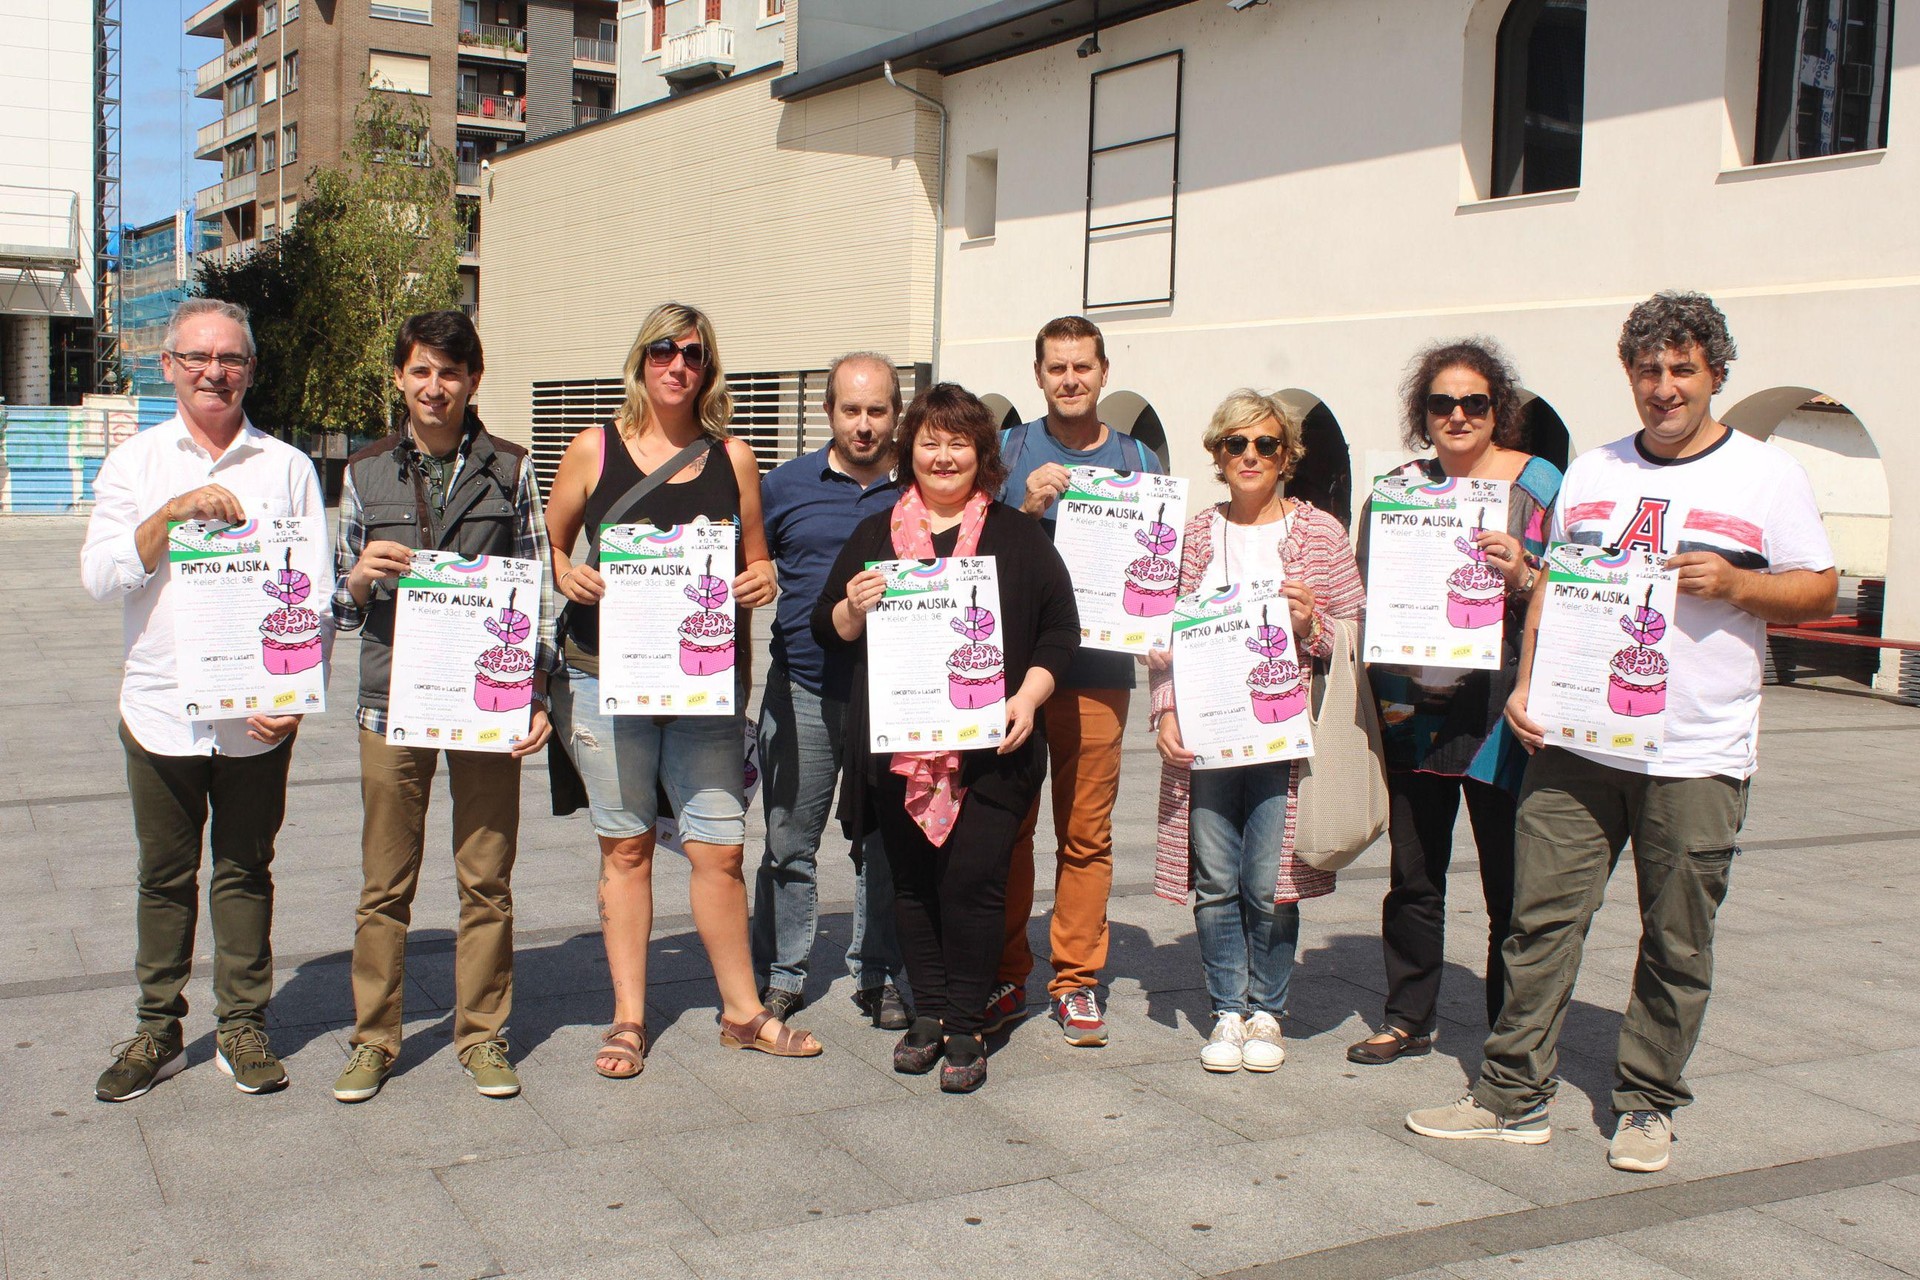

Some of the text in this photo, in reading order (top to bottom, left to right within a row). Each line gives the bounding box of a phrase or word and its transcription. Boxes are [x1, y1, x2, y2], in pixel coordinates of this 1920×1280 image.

[1154, 477, 1160, 485] 16
[1471, 480, 1479, 489] 16
[1068, 502, 1144, 521] PINTXO MUSIKA
[273, 520, 282, 529] 16
[1076, 518, 1096, 526] Keler
[1381, 514, 1463, 528] PINTXO MUSIKA
[1610, 497, 1670, 555] A
[697, 528, 705, 536] 16
[1390, 529, 1411, 537] Keler
[503, 560, 511, 568] 16
[960, 559, 968, 568] 16
[1644, 555, 1652, 564] 16
[181, 561, 270, 575] PINTXO MUSIKA
[610, 564, 691, 575] PINTXO MUSIKA
[242, 576, 253, 584] 3€
[665, 579, 675, 587] 3€
[1252, 581, 1259, 589] 16
[408, 590, 493, 607] PINTXO MUSIKA
[1555, 585, 1629, 605] PINTXO MUSIKA
[876, 598, 957, 611] PINTXO MUSIKA
[1562, 601, 1581, 609] Keler
[1603, 607, 1613, 615] 3€
[418, 607, 440, 615] Keler
[888, 614, 907, 622] Keler
[1181, 620, 1250, 640] PINTXO MUSIKA
[1228, 635, 1238, 643] 3€
